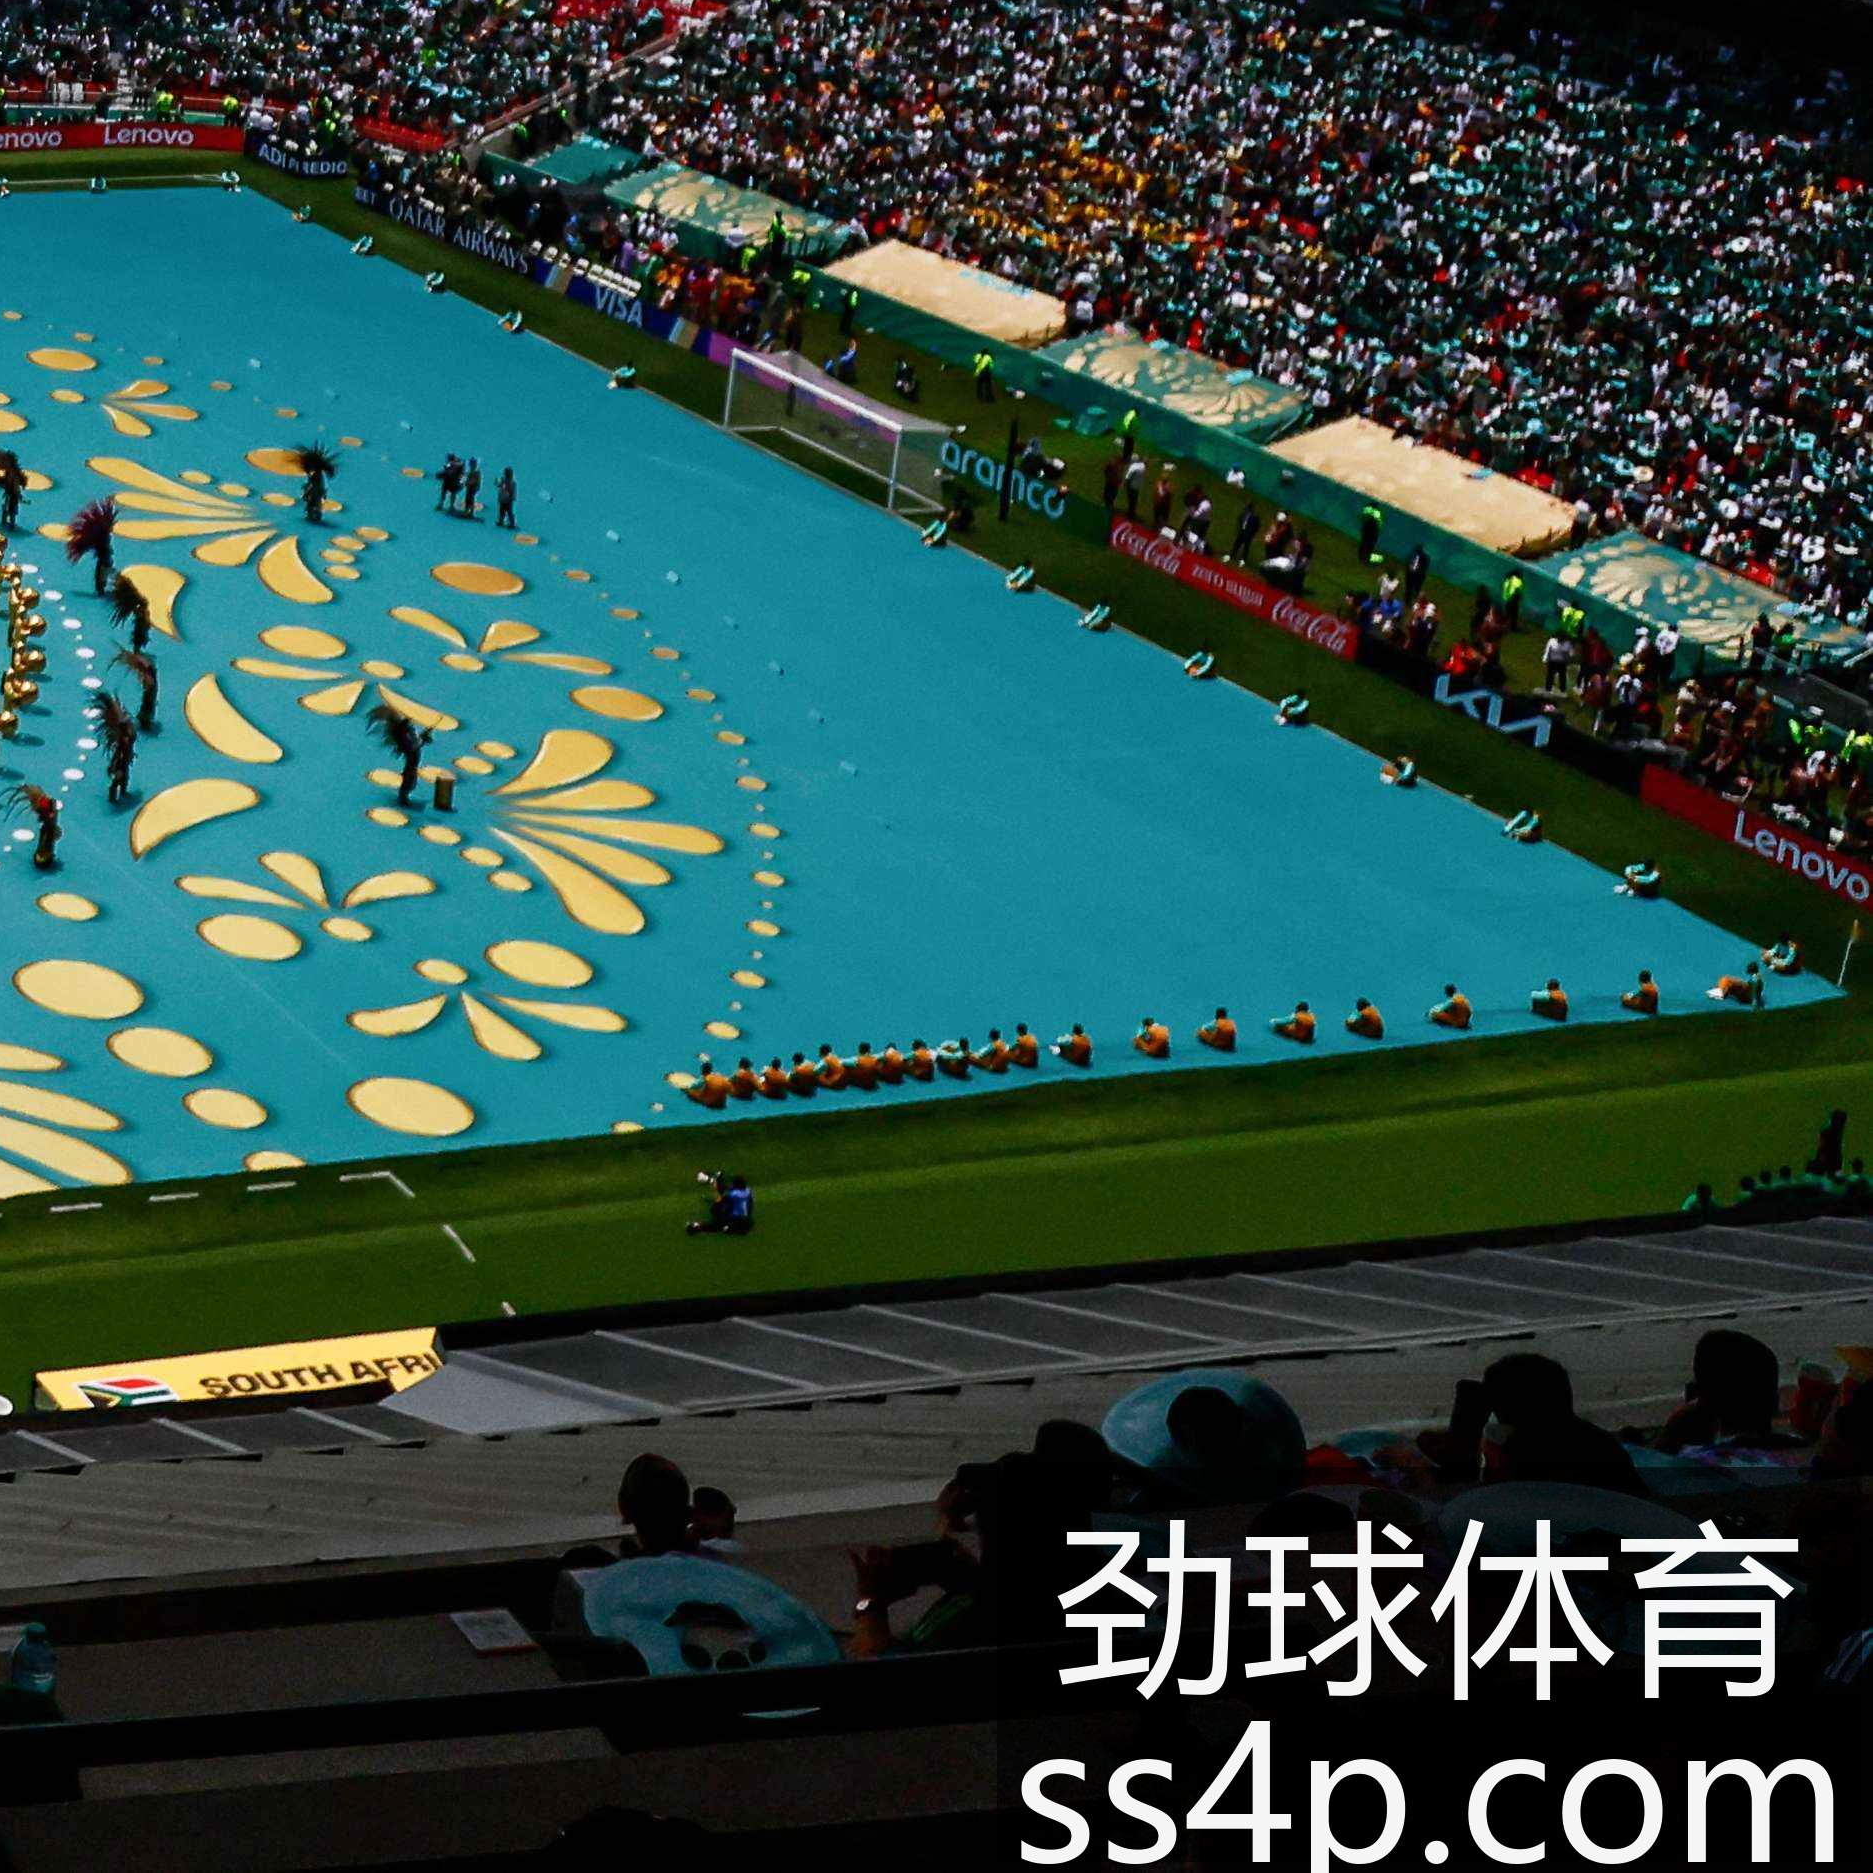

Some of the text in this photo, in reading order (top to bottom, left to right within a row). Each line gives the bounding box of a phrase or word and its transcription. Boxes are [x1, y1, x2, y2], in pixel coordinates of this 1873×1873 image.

[103, 125, 194, 147] Lenovo
[388, 197, 529, 276] QATAR AIRWAYS
[594, 284, 643, 329] VISA
[941, 438, 1066, 519] aramco
[1434, 672, 1552, 749] KIA
[1734, 809, 1871, 903] Lenovo
[199, 1364, 343, 1398] SOUTH
